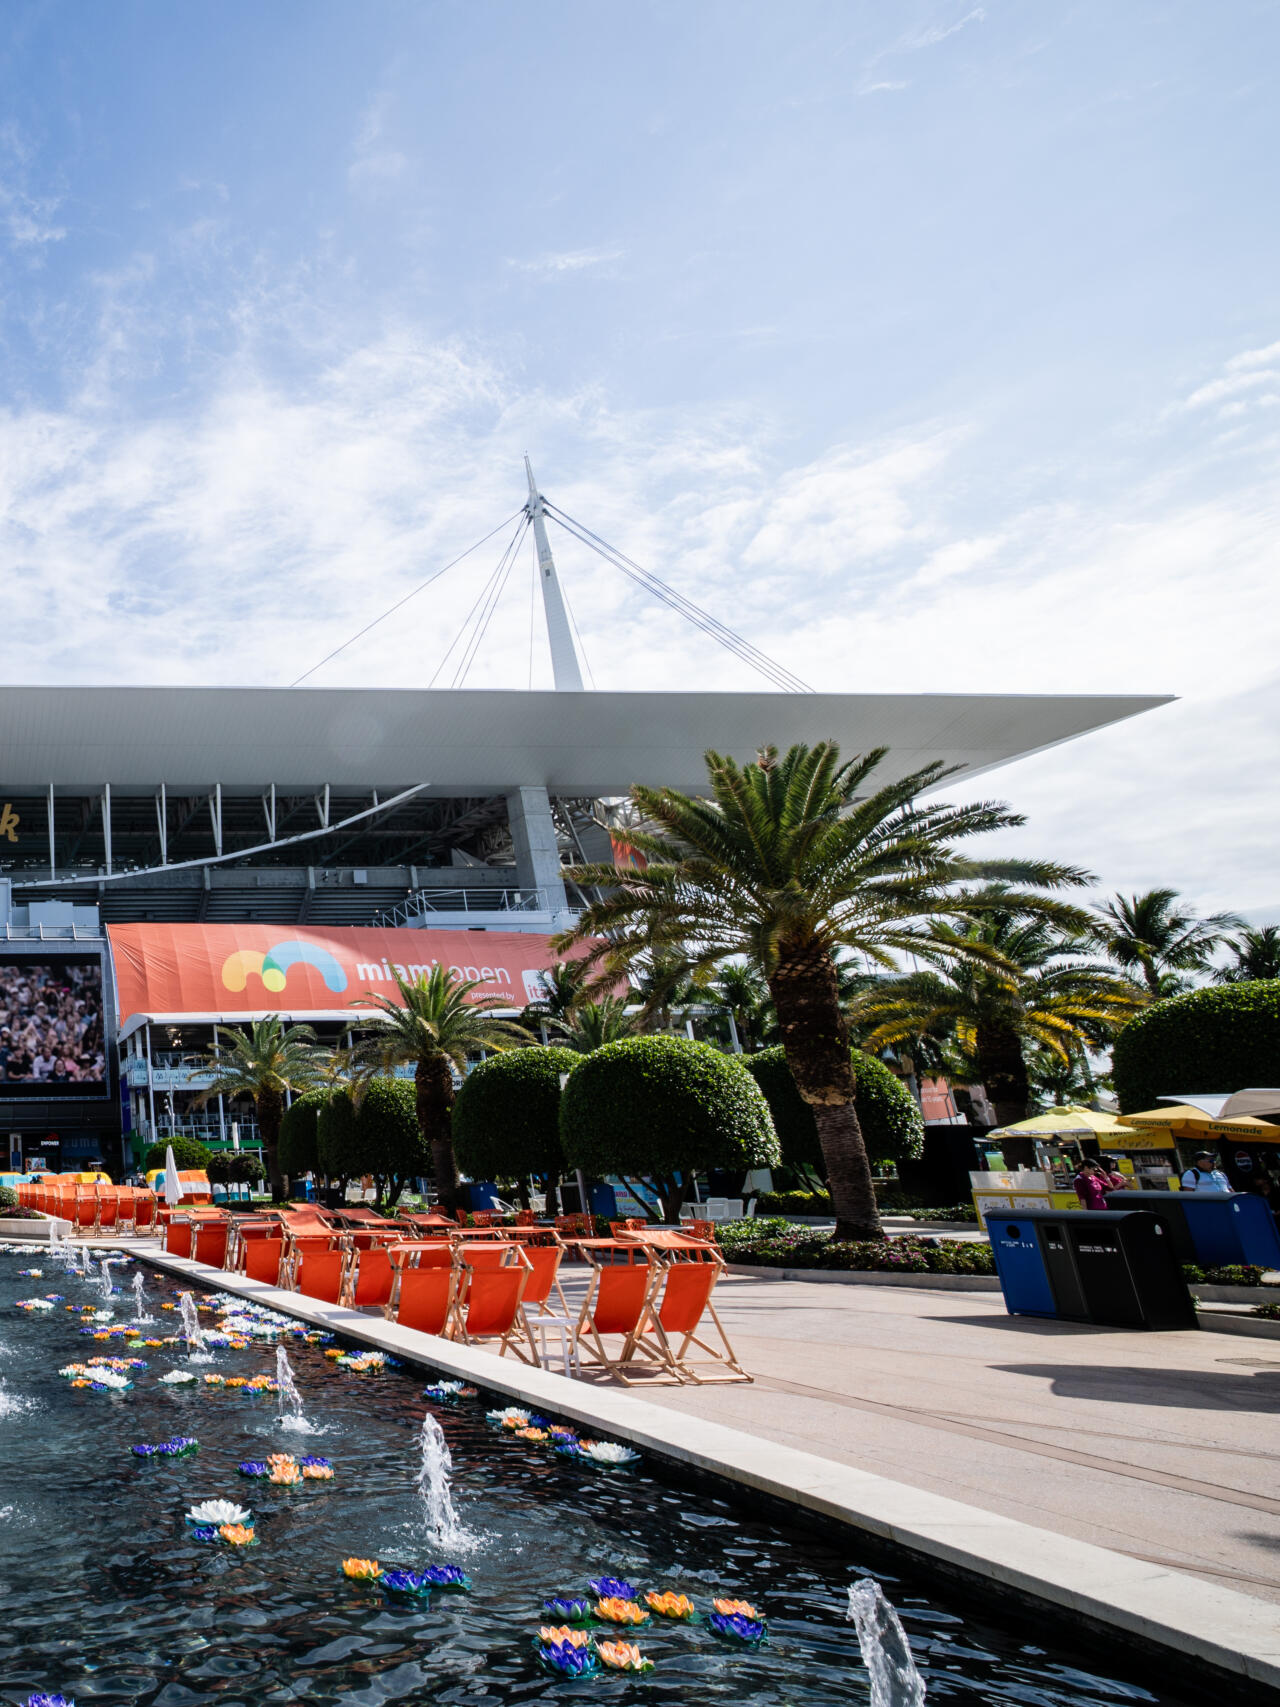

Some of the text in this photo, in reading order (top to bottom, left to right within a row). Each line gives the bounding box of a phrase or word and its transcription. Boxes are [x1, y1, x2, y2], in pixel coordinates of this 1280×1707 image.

[449, 965, 511, 986] open
[505, 992, 514, 1000] by
[1131, 1119, 1172, 1127] Lemonade
[1208, 1123, 1263, 1135] Lemonade
